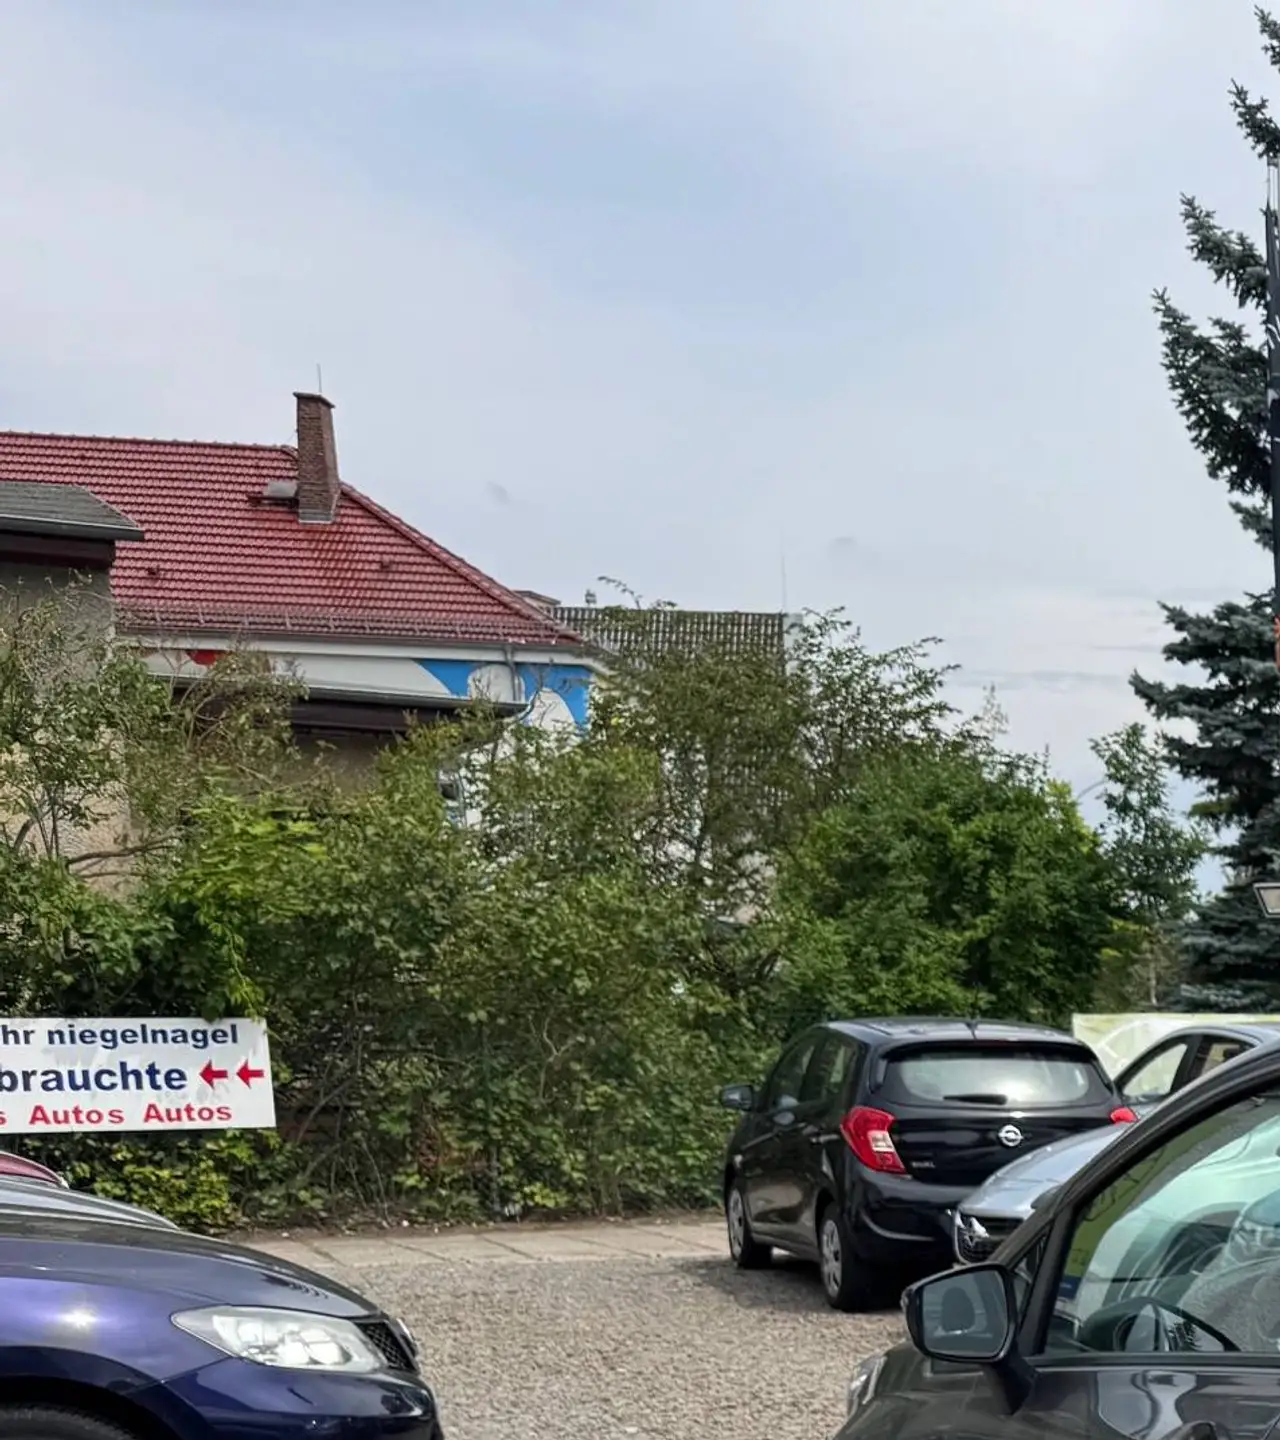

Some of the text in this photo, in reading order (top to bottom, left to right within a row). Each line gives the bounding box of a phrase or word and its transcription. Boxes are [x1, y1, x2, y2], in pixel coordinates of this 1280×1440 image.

[47, 1024, 238, 1050] niegelnagel
[29, 1104, 125, 1125] Autos
[143, 1103, 232, 1123] Autos
